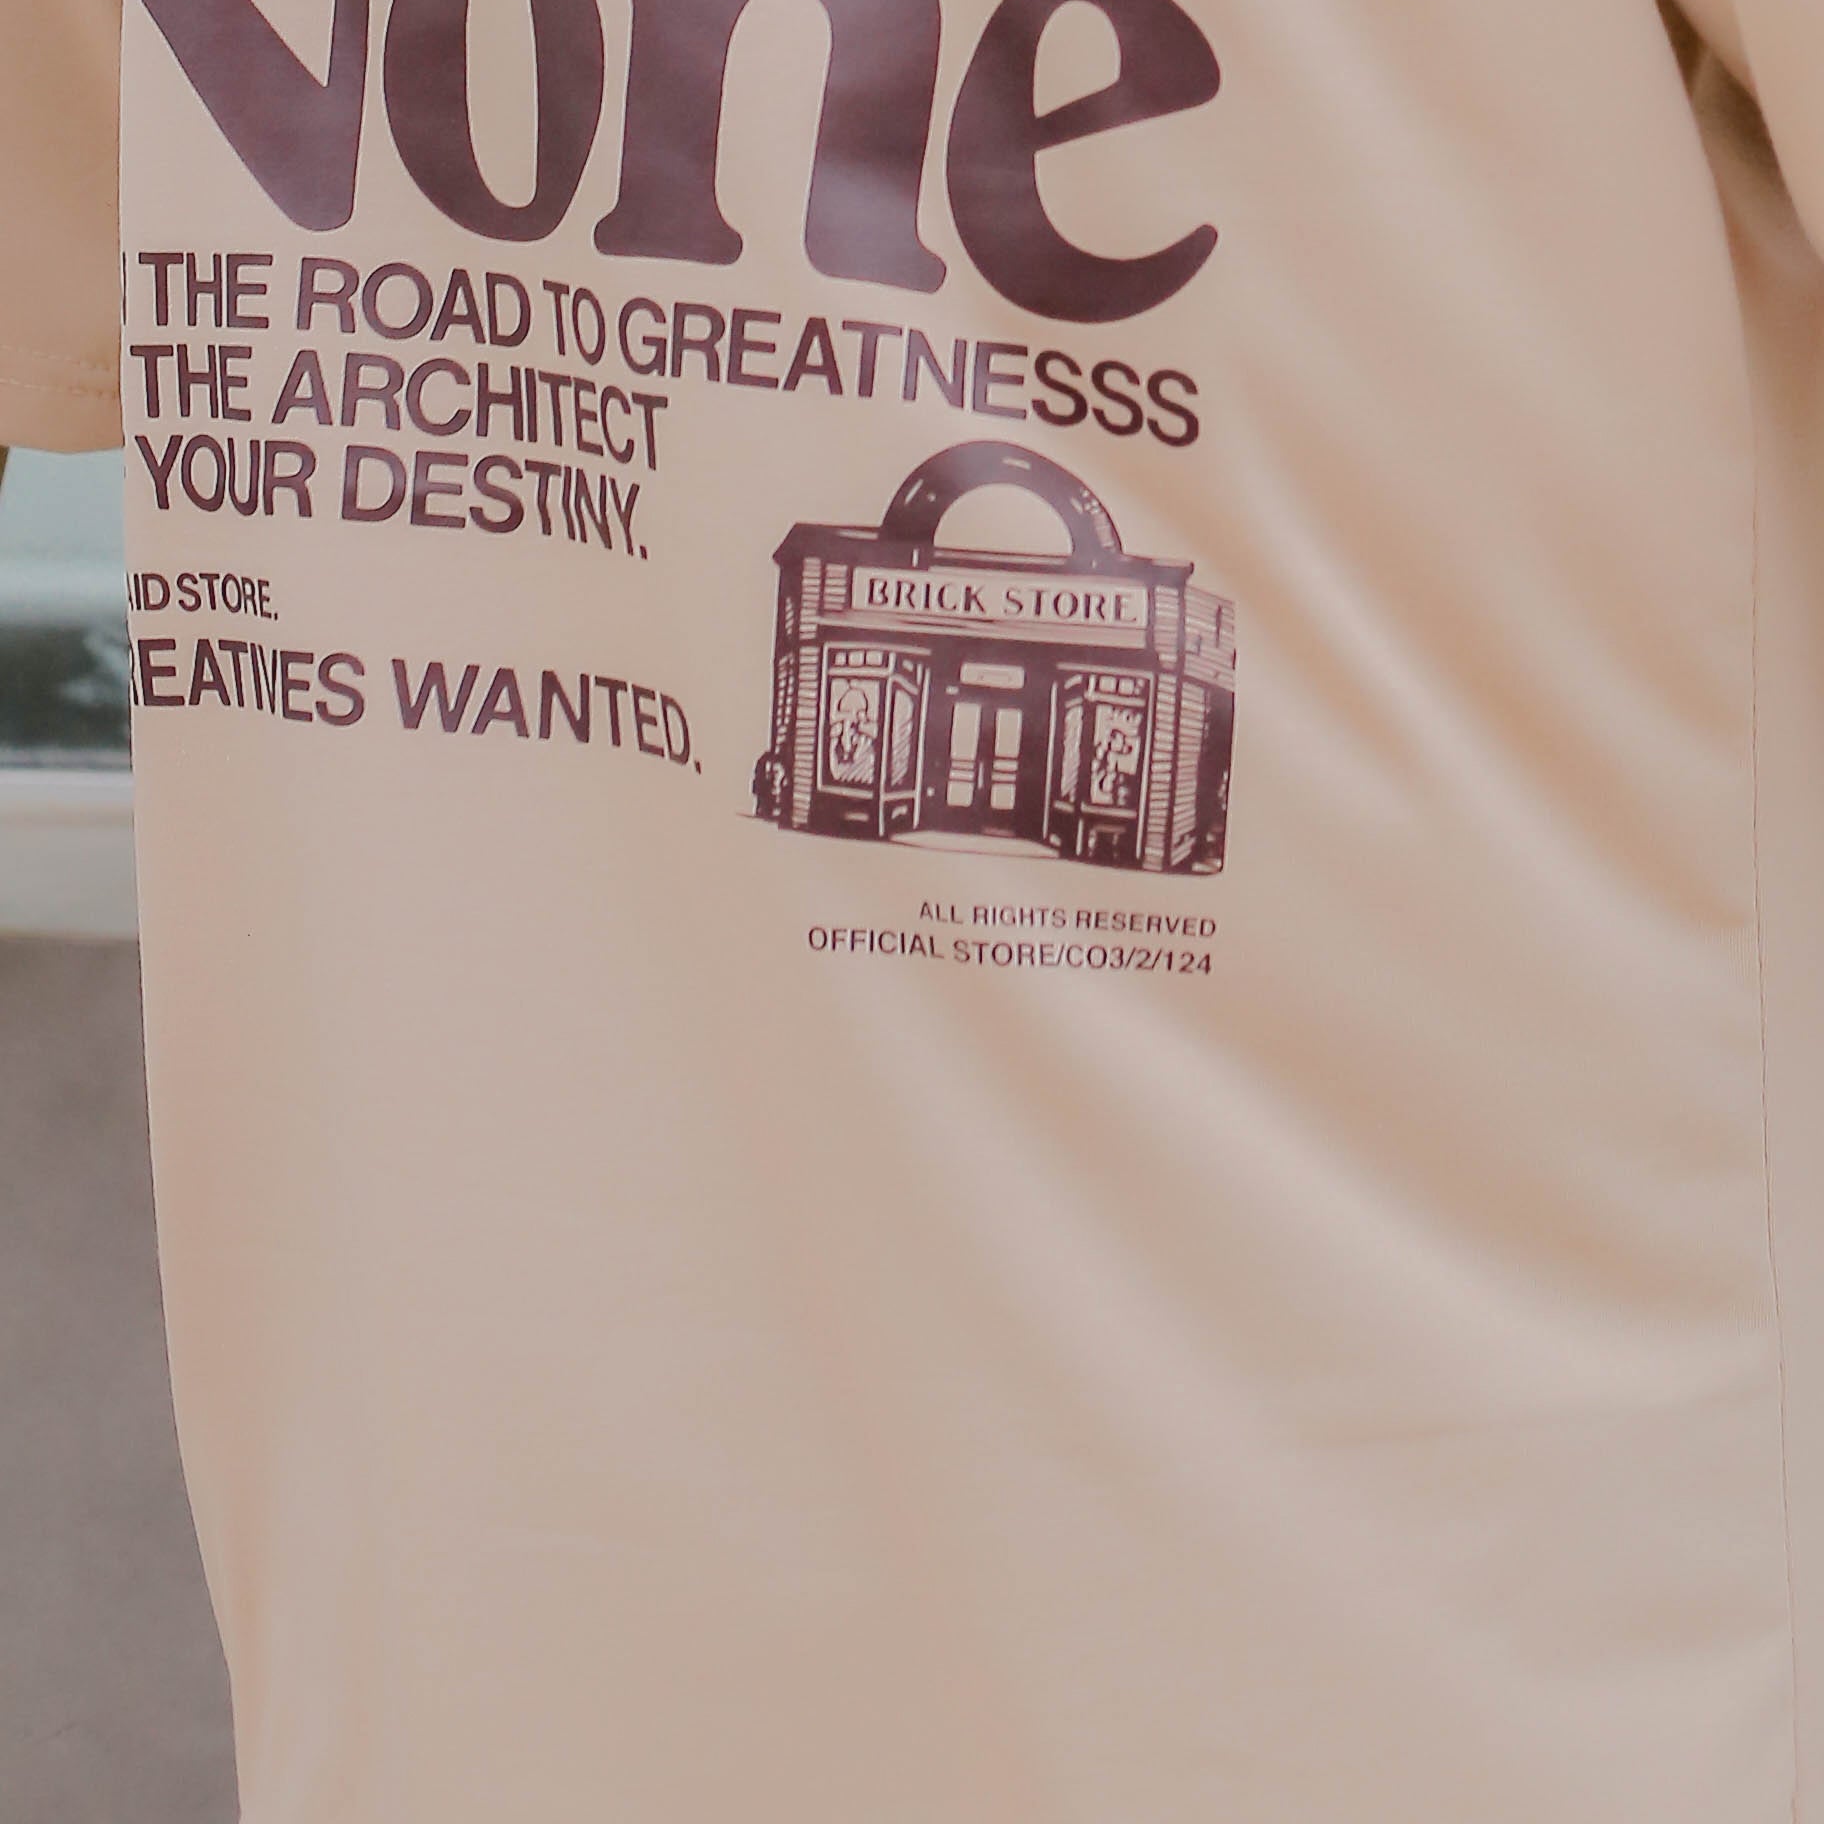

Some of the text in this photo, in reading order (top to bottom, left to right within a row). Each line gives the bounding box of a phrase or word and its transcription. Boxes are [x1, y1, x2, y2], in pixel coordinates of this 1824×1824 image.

[138, 252, 273, 329] THE
[296, 257, 532, 347] ROAD
[541, 280, 606, 366] TO
[618, 298, 1200, 447] GREATNESSS
[130, 343, 668, 471] THE ARCHITECT
[134, 434, 648, 560] YOUR DESTINY.
[126, 572, 279, 621] ID STORE.
[867, 577, 1138, 623] BRICK STORE
[391, 658, 702, 774] WANTED.
[808, 926, 945, 960] OFFICIAL
[920, 901, 1217, 938] ALL RIGHTS RESERVED
